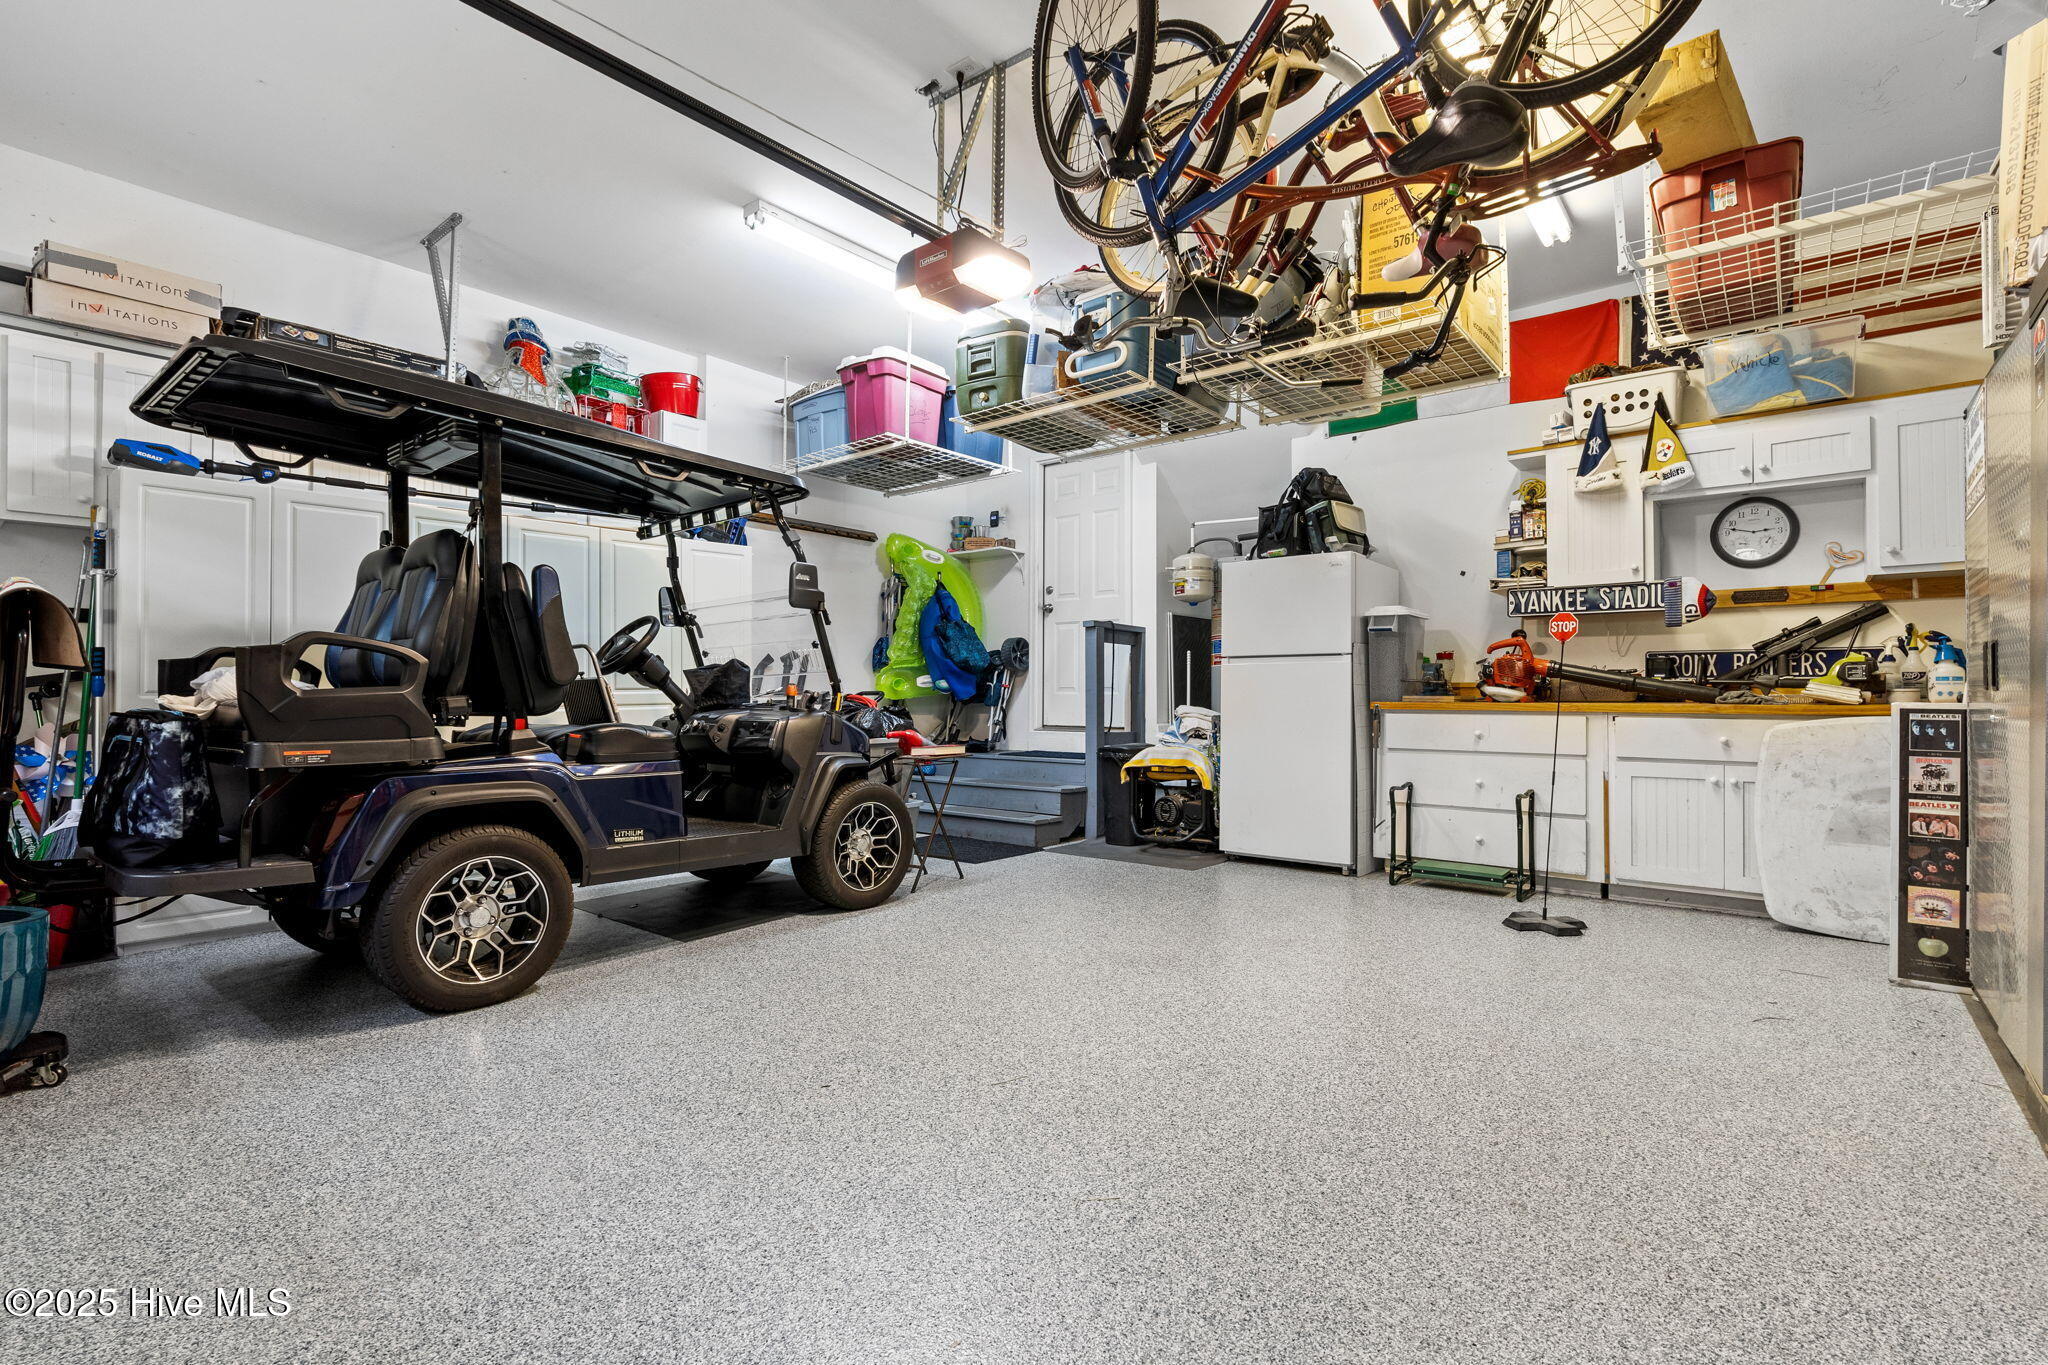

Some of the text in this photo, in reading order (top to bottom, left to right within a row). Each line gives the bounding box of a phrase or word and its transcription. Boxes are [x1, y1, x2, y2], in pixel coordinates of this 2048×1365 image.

[1200, 31, 1257, 118] DIAMONDBACK
[1331, 177, 1388, 194] EARTH CRUISER
[2019, 160, 2038, 226] OUTDOOR
[2014, 222, 2032, 271] DECOR
[136, 450, 165, 462] KOBALT
[1517, 584, 1665, 613] YANKEE STADIU
[1551, 621, 1577, 633] STOP
[1732, 651, 1828, 676] BOMERS
[613, 829, 644, 838] LITHIUM
